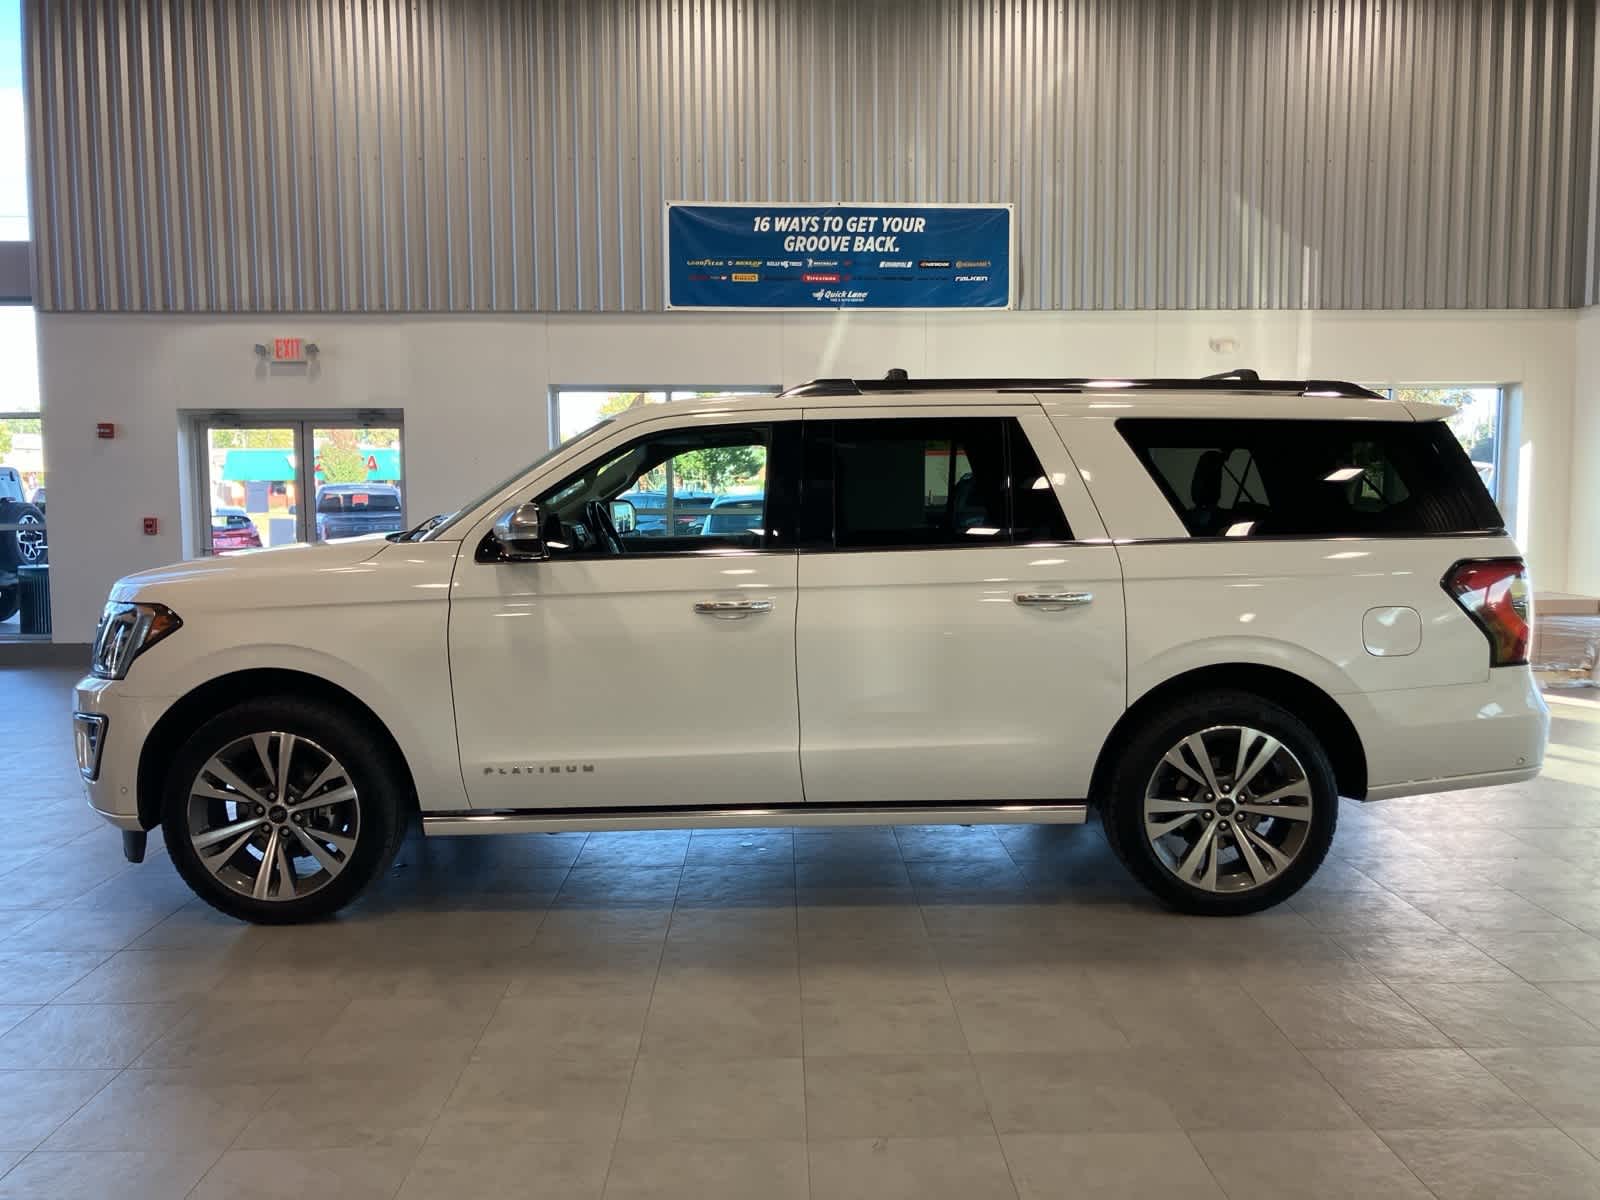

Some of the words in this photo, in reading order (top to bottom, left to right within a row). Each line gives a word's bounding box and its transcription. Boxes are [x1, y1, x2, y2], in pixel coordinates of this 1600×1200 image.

[753, 216, 770, 232] 16
[774, 216, 820, 233] WAYS
[823, 216, 843, 233] TO
[846, 217, 878, 233] GET
[882, 217, 927, 233] YOUR
[783, 235, 850, 253] GROOVE
[853, 236, 900, 253] BACK.
[824, 290, 848, 299] Quick
[847, 290, 869, 298] Lane
[274, 337, 303, 360] EXIT
[483, 764, 595, 775] PLATINUM
